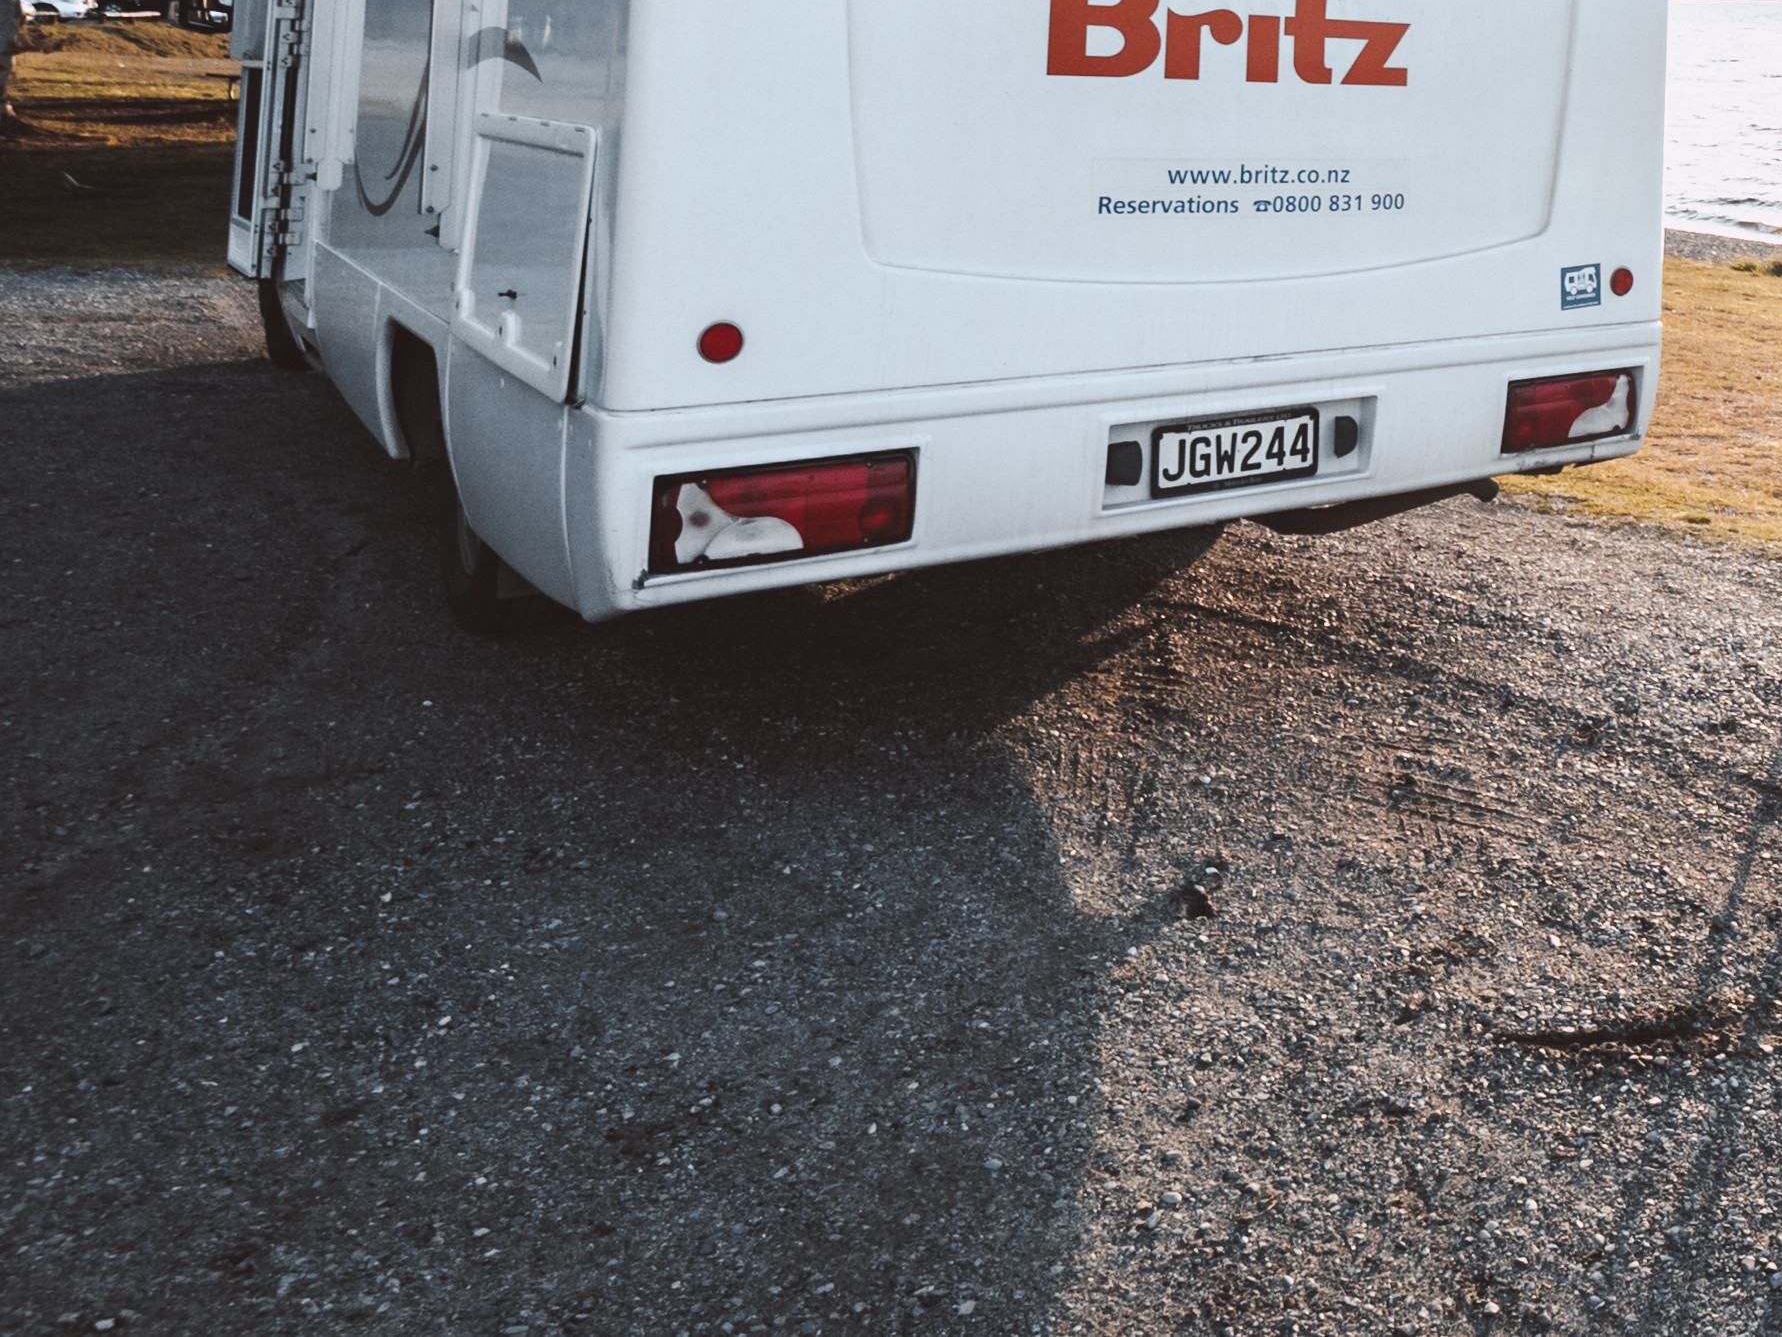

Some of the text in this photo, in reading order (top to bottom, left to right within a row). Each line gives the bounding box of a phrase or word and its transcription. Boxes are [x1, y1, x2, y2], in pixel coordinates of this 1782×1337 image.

[1167, 164, 1351, 184] www.britz.co.nz
[1098, 195, 1240, 214] Reservations
[1328, 194, 1363, 212] 831
[1371, 193, 1406, 211] 900
[1162, 423, 1311, 482] JGW244
